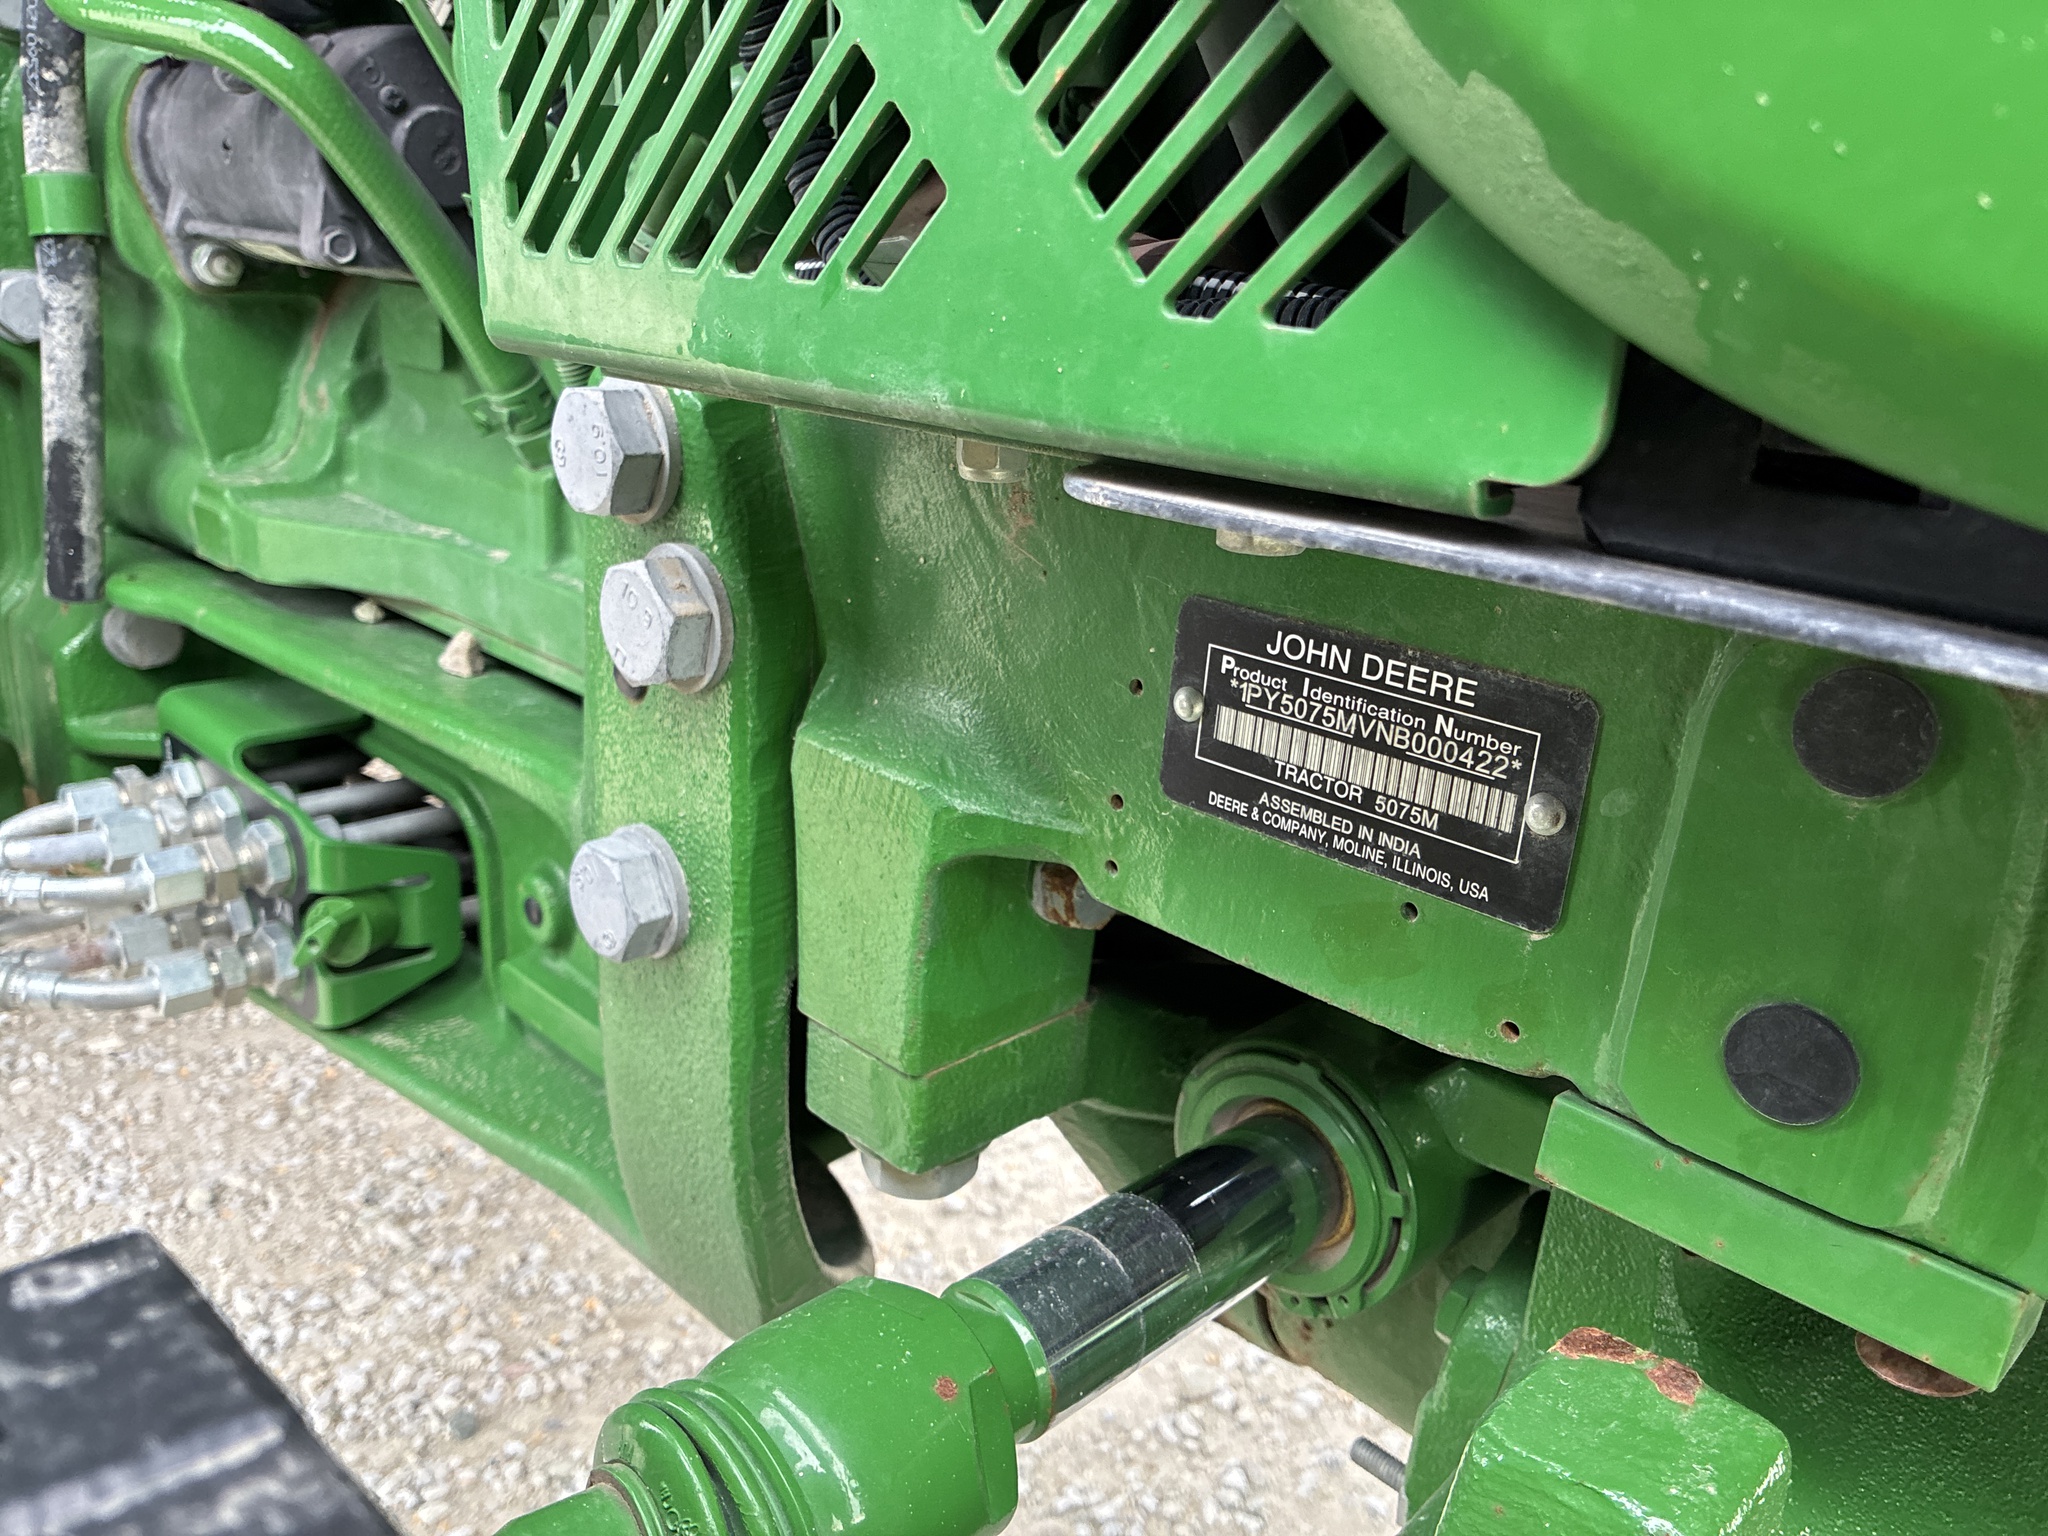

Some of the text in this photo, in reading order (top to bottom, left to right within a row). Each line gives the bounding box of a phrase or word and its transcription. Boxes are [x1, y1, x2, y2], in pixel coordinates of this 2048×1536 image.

[1221, 655, 1522, 756] Product Identification Number
[1266, 631, 1478, 708] JOHN DEERE
[1259, 792, 1421, 859] ASSEMBLED IN INDIA
[1275, 760, 1439, 831] TRACTOR 5075M
[1208, 791, 1489, 902] DEERE & COMPANY, MOLINE, ILLINOIS, USA
